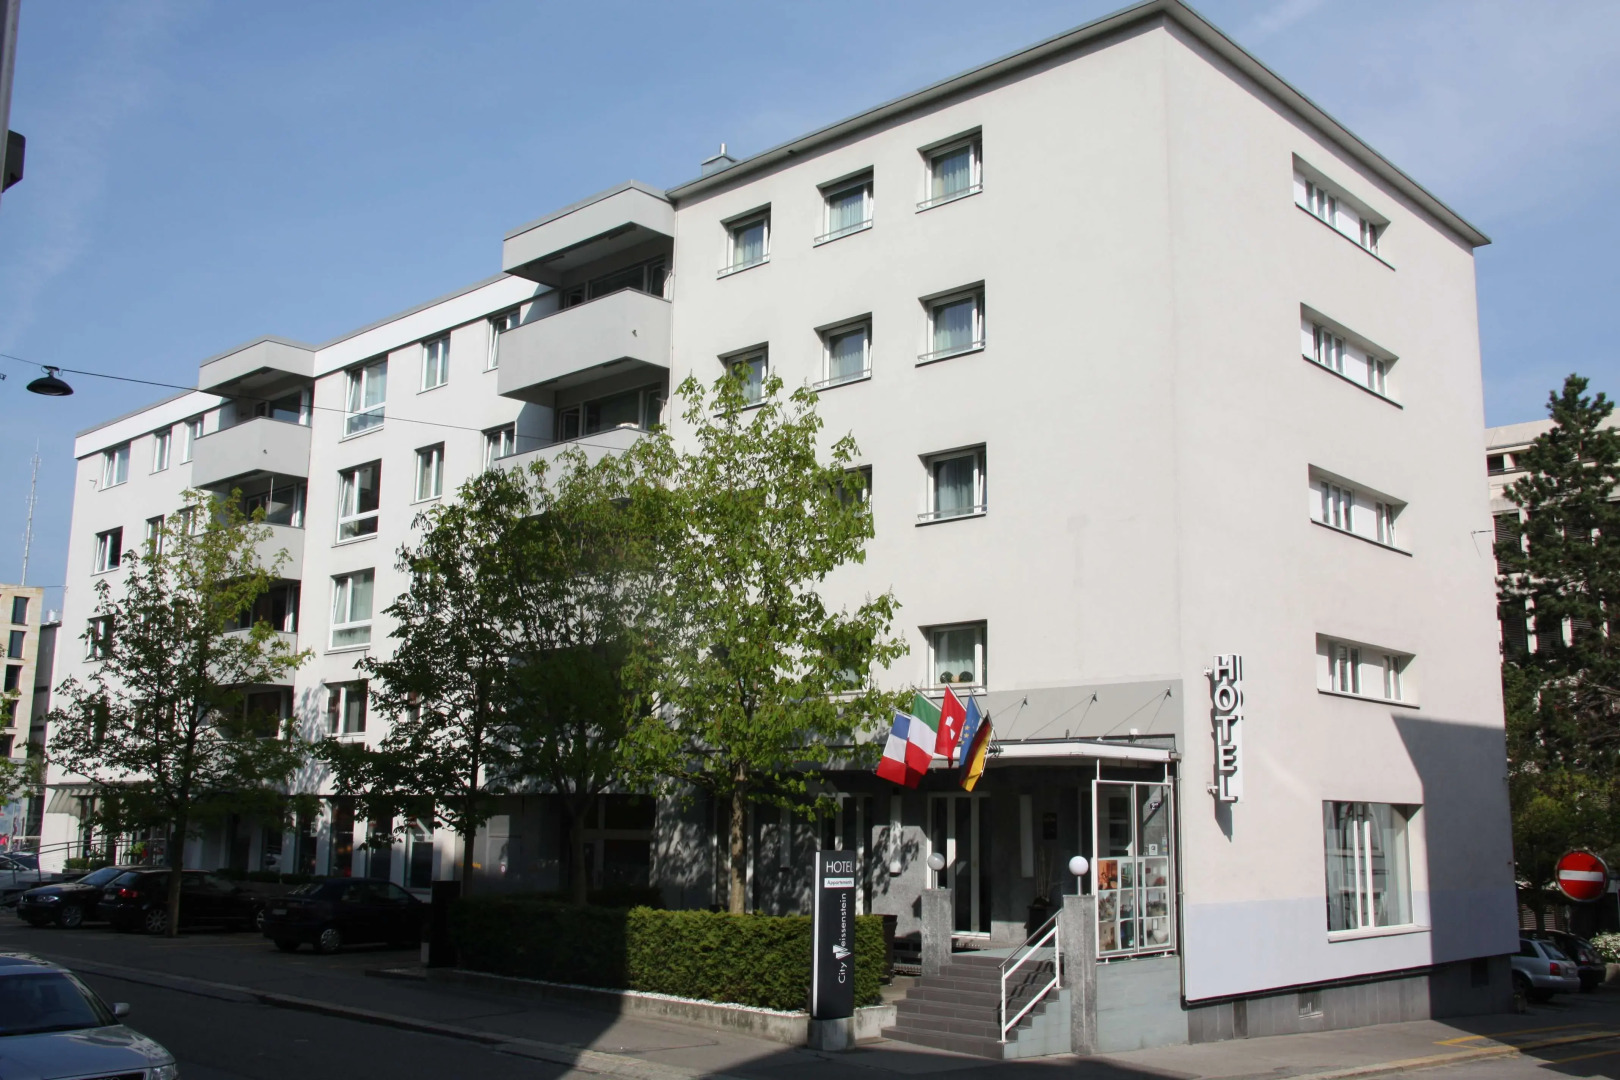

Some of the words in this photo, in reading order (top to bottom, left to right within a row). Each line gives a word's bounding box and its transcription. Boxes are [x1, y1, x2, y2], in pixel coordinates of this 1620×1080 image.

[1213, 655, 1238, 802] HOTEL
[826, 860, 853, 873] HOTEL
[832, 893, 851, 960] Weissenstein
[838, 962, 847, 983] City
